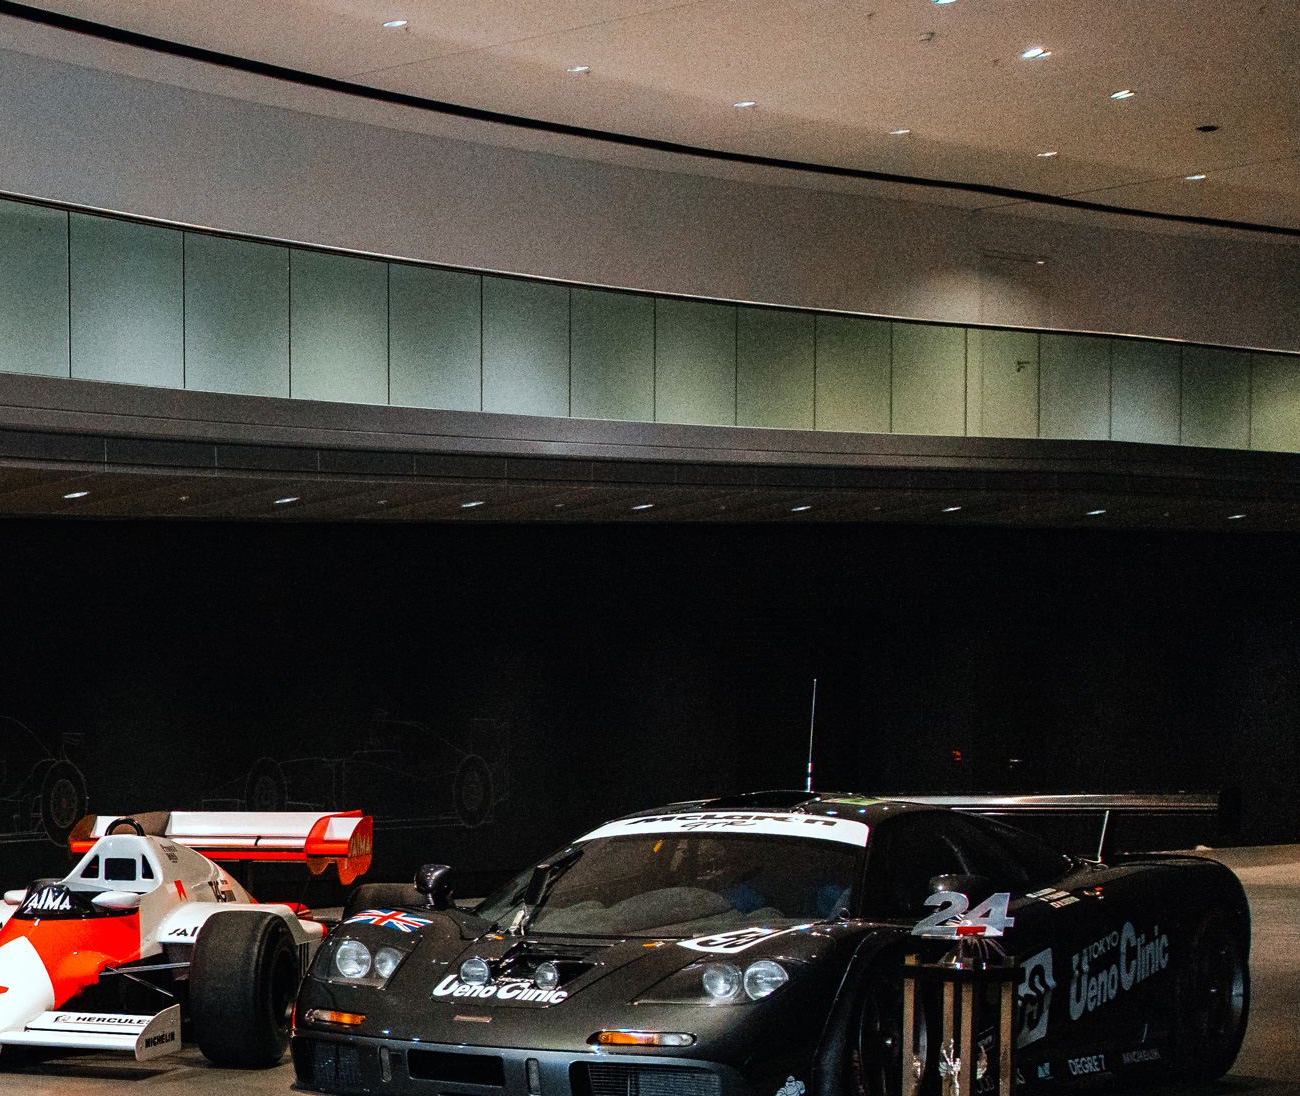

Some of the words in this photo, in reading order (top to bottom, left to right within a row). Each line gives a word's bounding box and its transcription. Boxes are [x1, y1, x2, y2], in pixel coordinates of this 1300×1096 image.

[911, 890, 1015, 939] 24
[1088, 931, 1119, 962] TOKYO
[432, 974, 497, 997] Ueno
[496, 982, 569, 1004] Clinic
[1069, 948, 1119, 1021] Ueno
[1120, 921, 1170, 991] Clinic
